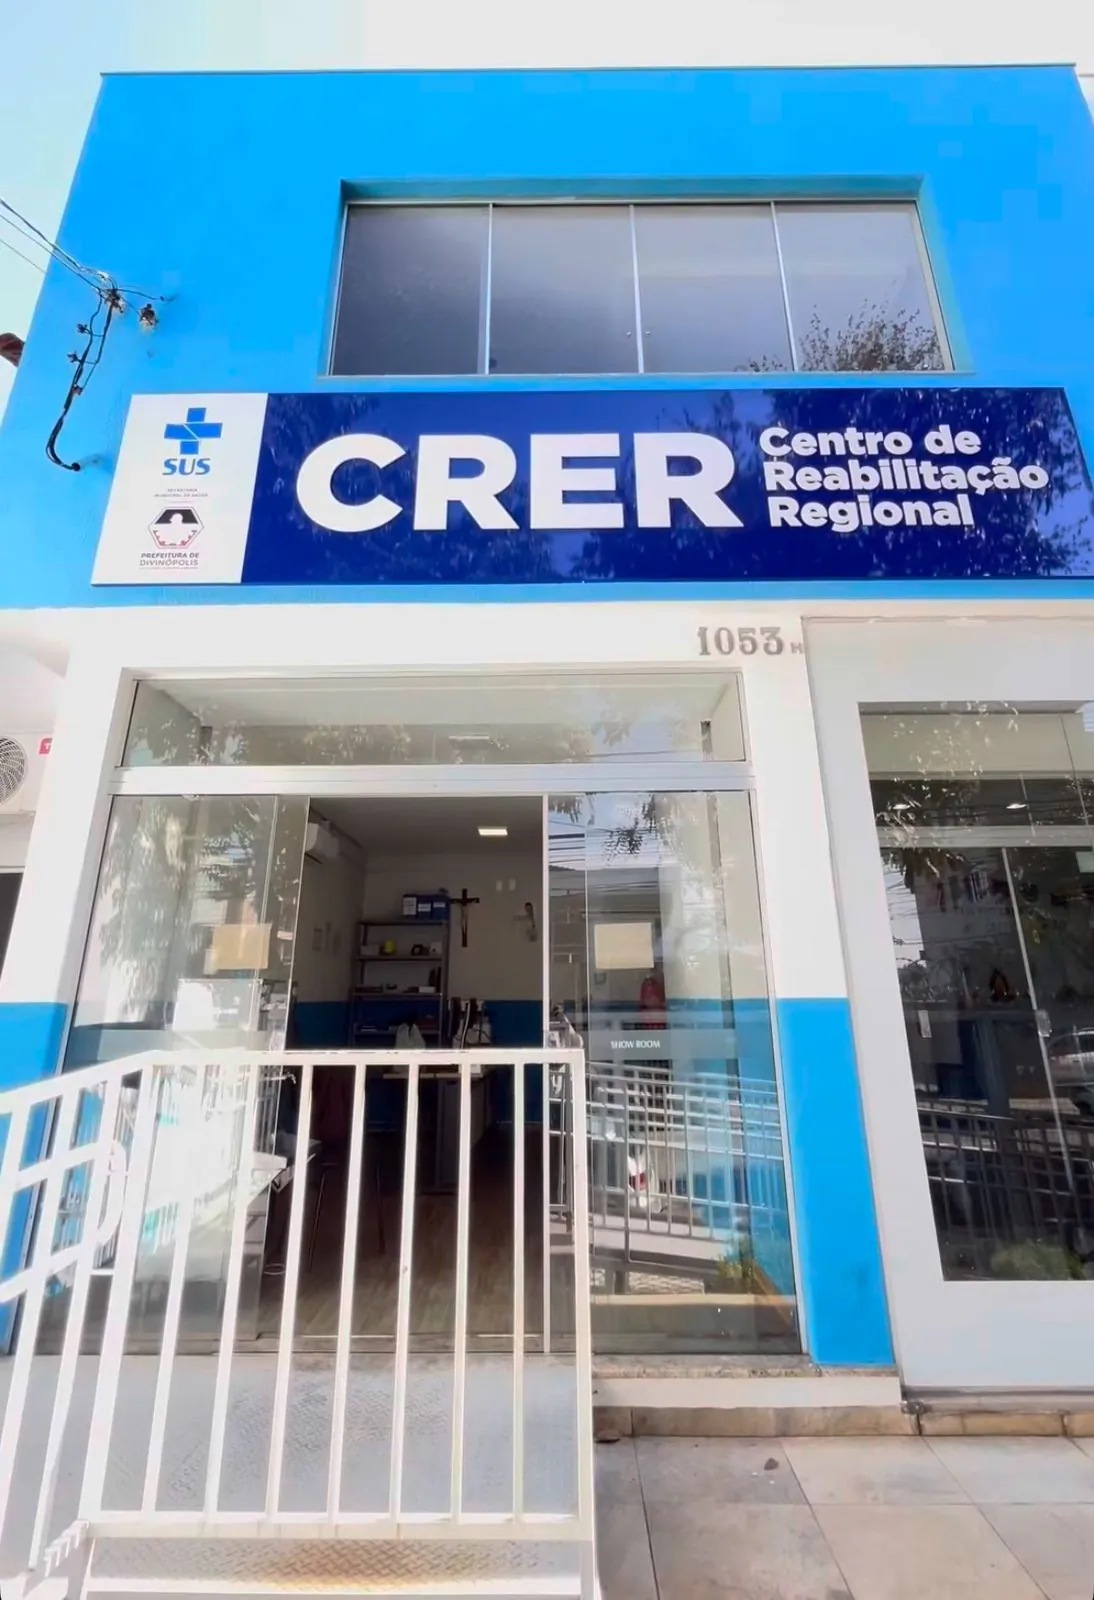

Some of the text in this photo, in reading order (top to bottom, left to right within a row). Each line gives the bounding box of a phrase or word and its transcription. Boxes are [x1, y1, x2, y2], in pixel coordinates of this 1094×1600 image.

[759, 424, 982, 456] Centro de
[162, 458, 210, 475] SUS
[296, 433, 745, 532] CRER
[763, 457, 1049, 495] Reabilitação
[768, 494, 974, 533] Regional
[697, 626, 784, 655] 1053
[610, 1040, 660, 1049] SHOW ROOM
